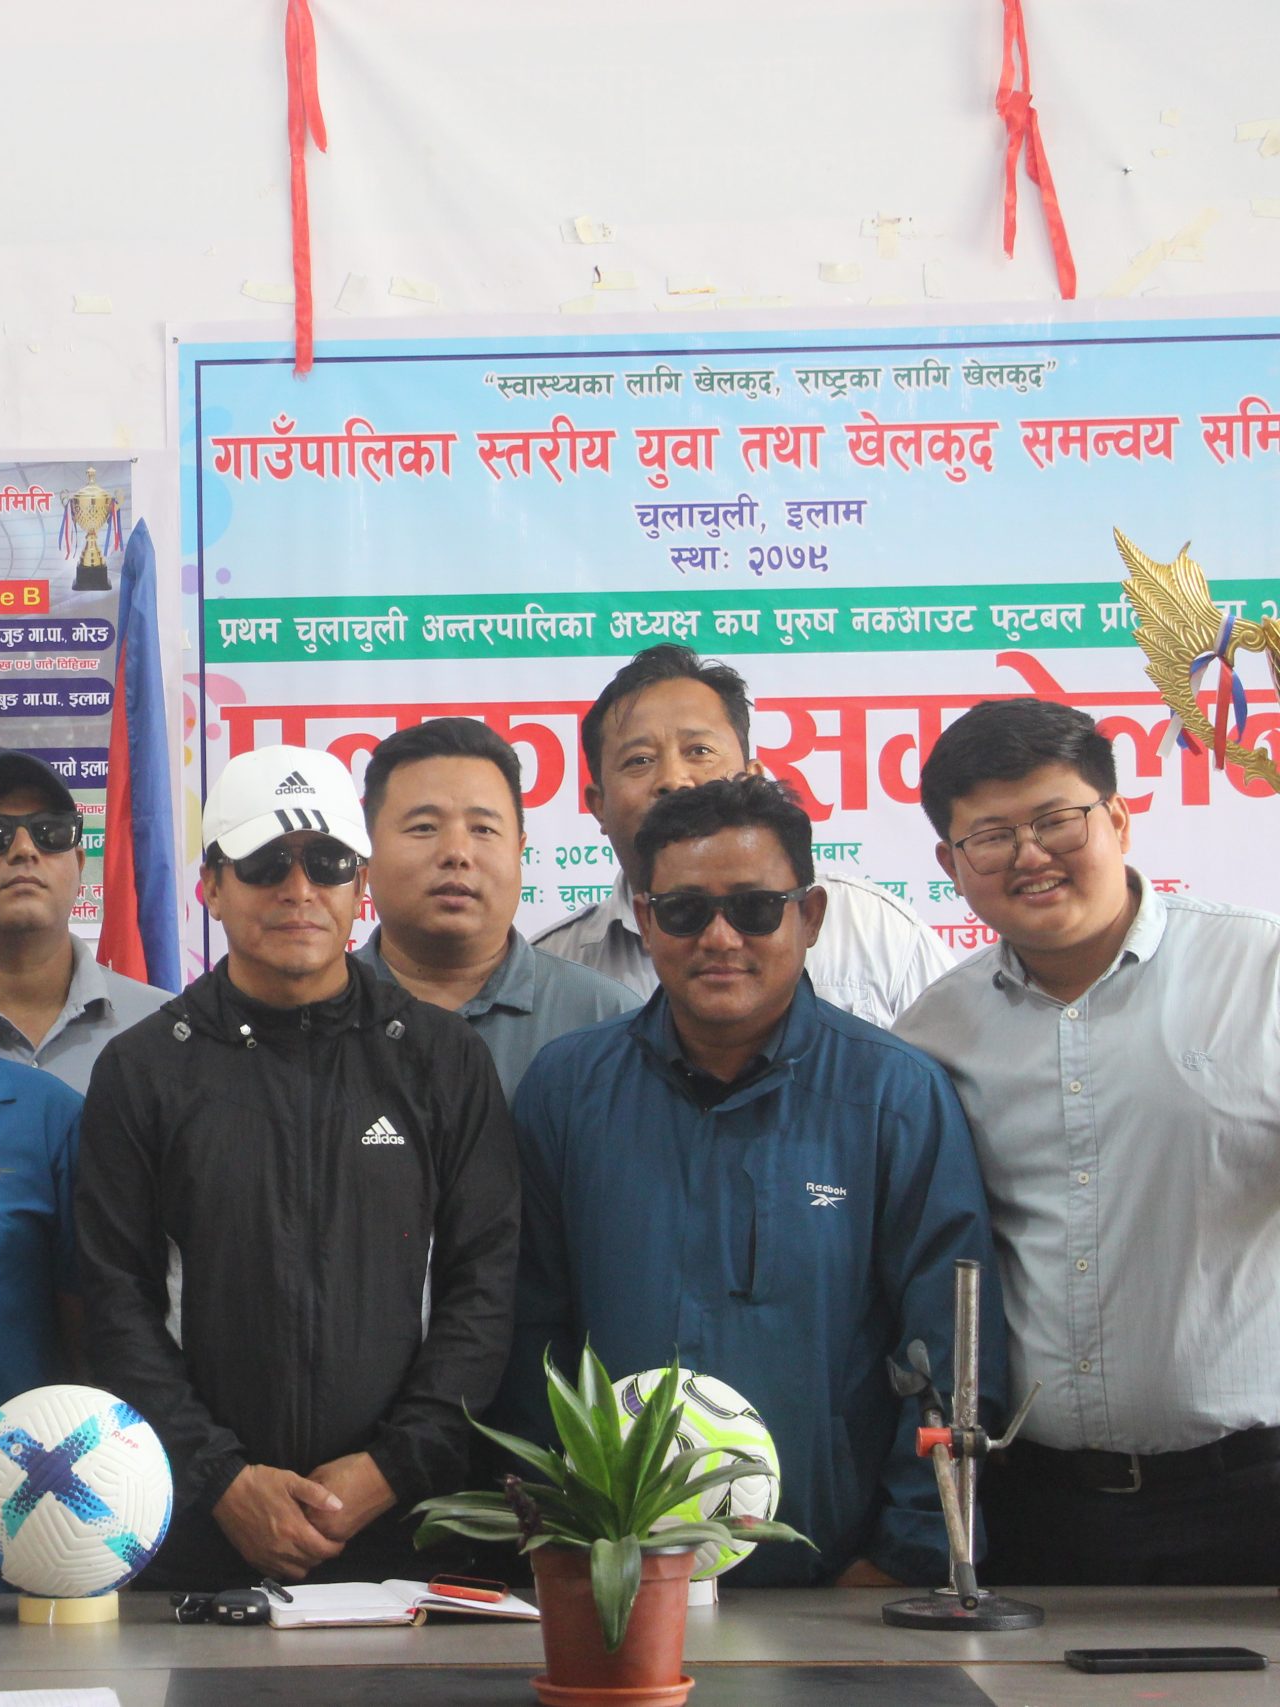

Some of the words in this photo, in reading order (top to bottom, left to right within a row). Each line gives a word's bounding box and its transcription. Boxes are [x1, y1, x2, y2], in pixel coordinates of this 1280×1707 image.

[626, 365, 683, 395] लागि
[694, 365, 781, 399] खेलकुद,
[796, 368, 881, 397] राष्ट्रका
[893, 359, 950, 388] लागि
[212, 413, 457, 482] गाउँपालिका
[476, 415, 616, 484] स्तरीय
[634, 427, 720, 489] युवा
[740, 425, 825, 472] तथा
[845, 410, 999, 483] खेलकुद
[1019, 415, 1180, 469] समन्वय
[1201, 396, 1280, 464] समि
[634, 493, 766, 539] चुलाचुली,
[786, 499, 867, 532] इलाम
[748, 544, 830, 576] २०७९
[23, 587, 41, 606] B
[219, 618, 282, 649] प्रथम
[295, 606, 409, 653] चुलाचुली
[423, 603, 596, 646] अन्तरपालिका
[610, 609, 699, 640] अध्यक्ष
[714, 608, 761, 637] कप
[851, 605, 977, 635] नकआउट
[991, 603, 1086, 642] फुटबल
[69, 691, 110, 708] इलाम
[275, 785, 316, 796] adidas
[361, 1133, 406, 1146] adidas
[806, 1182, 847, 1196] Reebok
